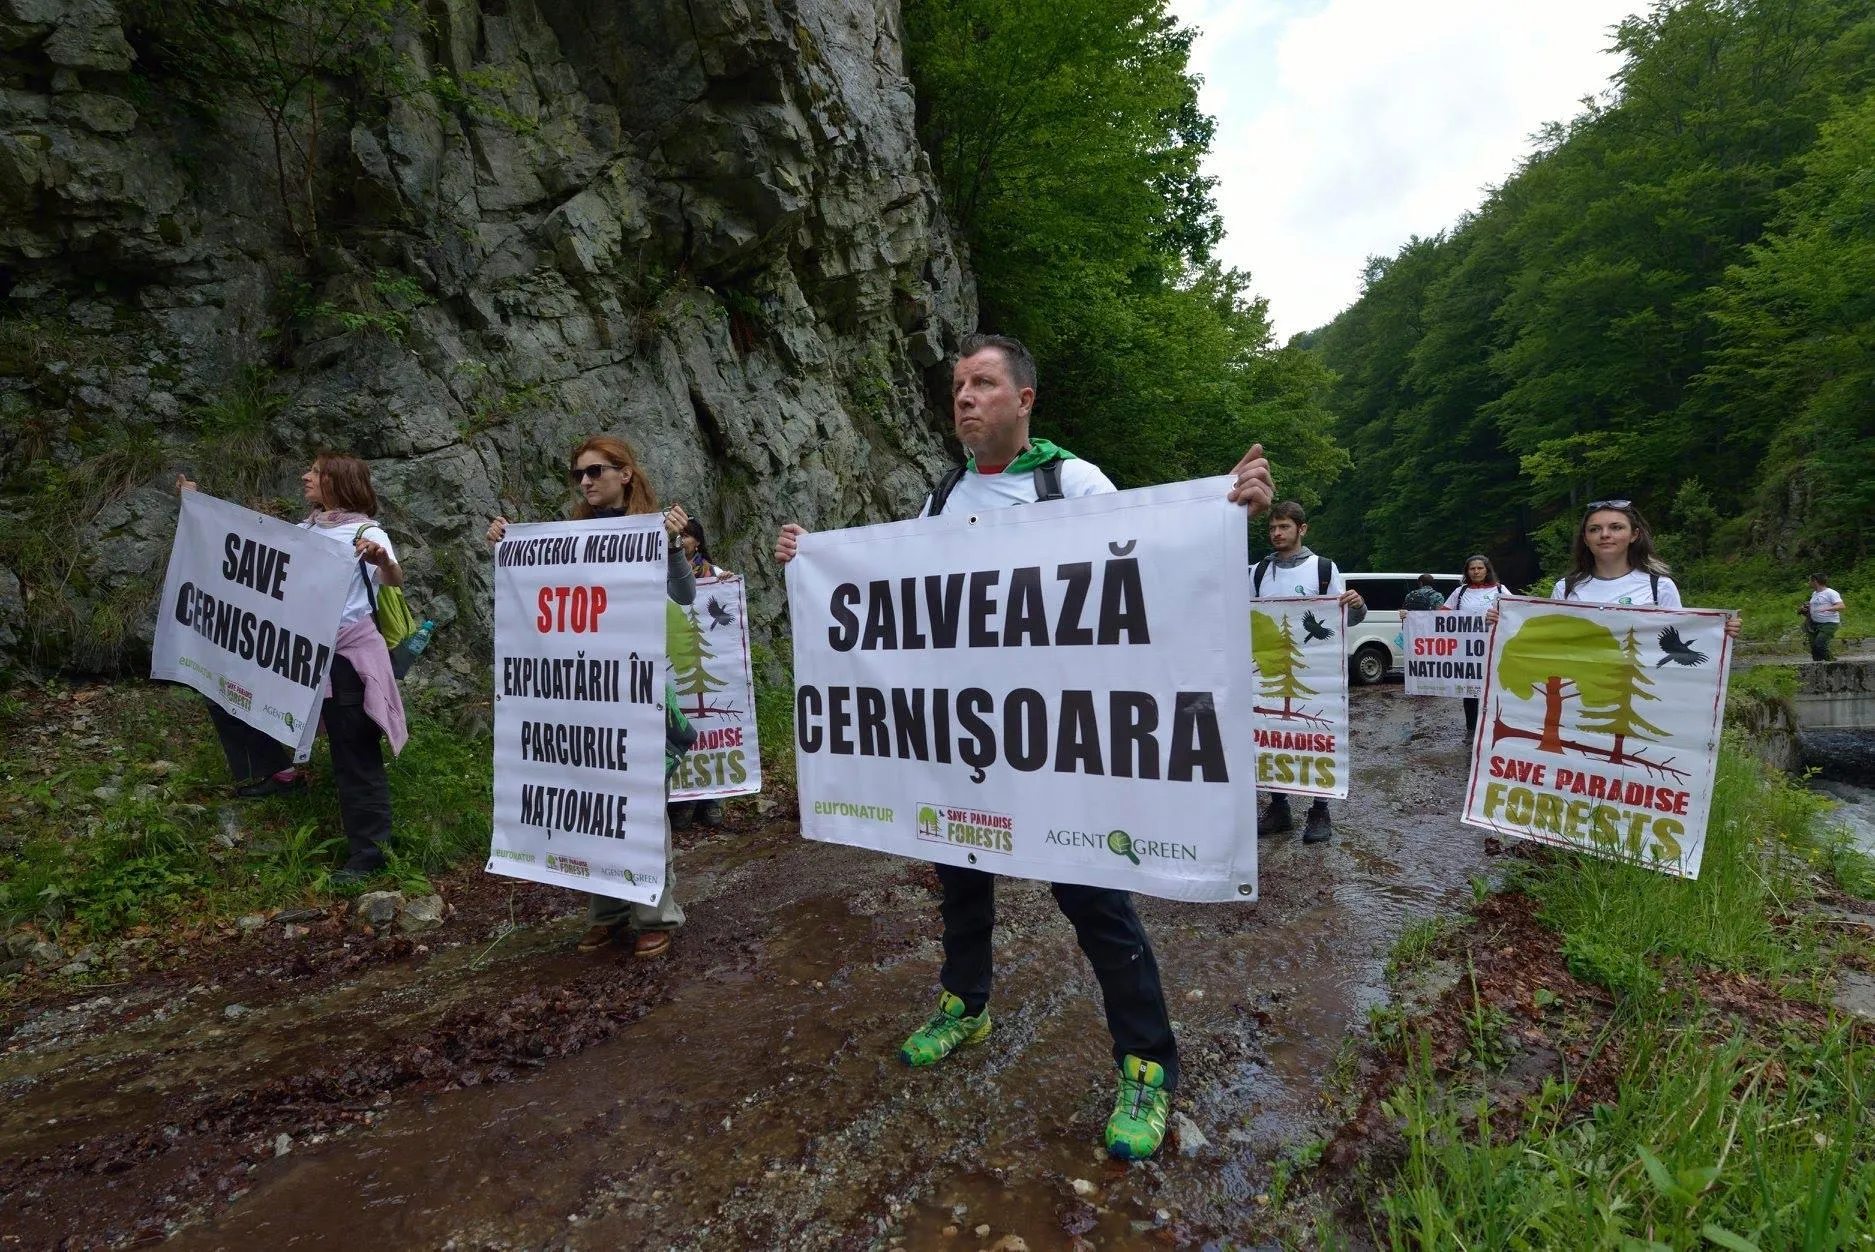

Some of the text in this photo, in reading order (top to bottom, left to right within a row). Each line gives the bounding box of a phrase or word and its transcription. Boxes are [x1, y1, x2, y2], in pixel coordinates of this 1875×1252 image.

[223, 532, 290, 601] SAVE
[499, 536, 577, 567] MINISTERUL
[537, 585, 607, 633] STOP
[828, 539, 1151, 652] SALVEAZĂ
[1414, 637, 1485, 657] STOP LO
[504, 651, 654, 704] EXPLOATĂRII ÎN
[1408, 661, 1483, 679] NATIONAL
[263, 704, 285, 720] AGENT
[521, 721, 628, 771] PARCURILE
[797, 684, 1229, 784] CERNIŞOARA
[1255, 752, 1336, 789] ESTS
[1489, 755, 1691, 816] SAVE PARADISE
[521, 784, 627, 840] NAȚIONALE
[947, 809, 1013, 830] SAVE PARADISE
[1483, 781, 1685, 860] FORESTS
[947, 823, 1013, 852] FORESTS
[1045, 828, 1197, 861] AGENT GREEN
[560, 863, 590, 877] FORESTS
[601, 867, 659, 884] AGENT GREEN
